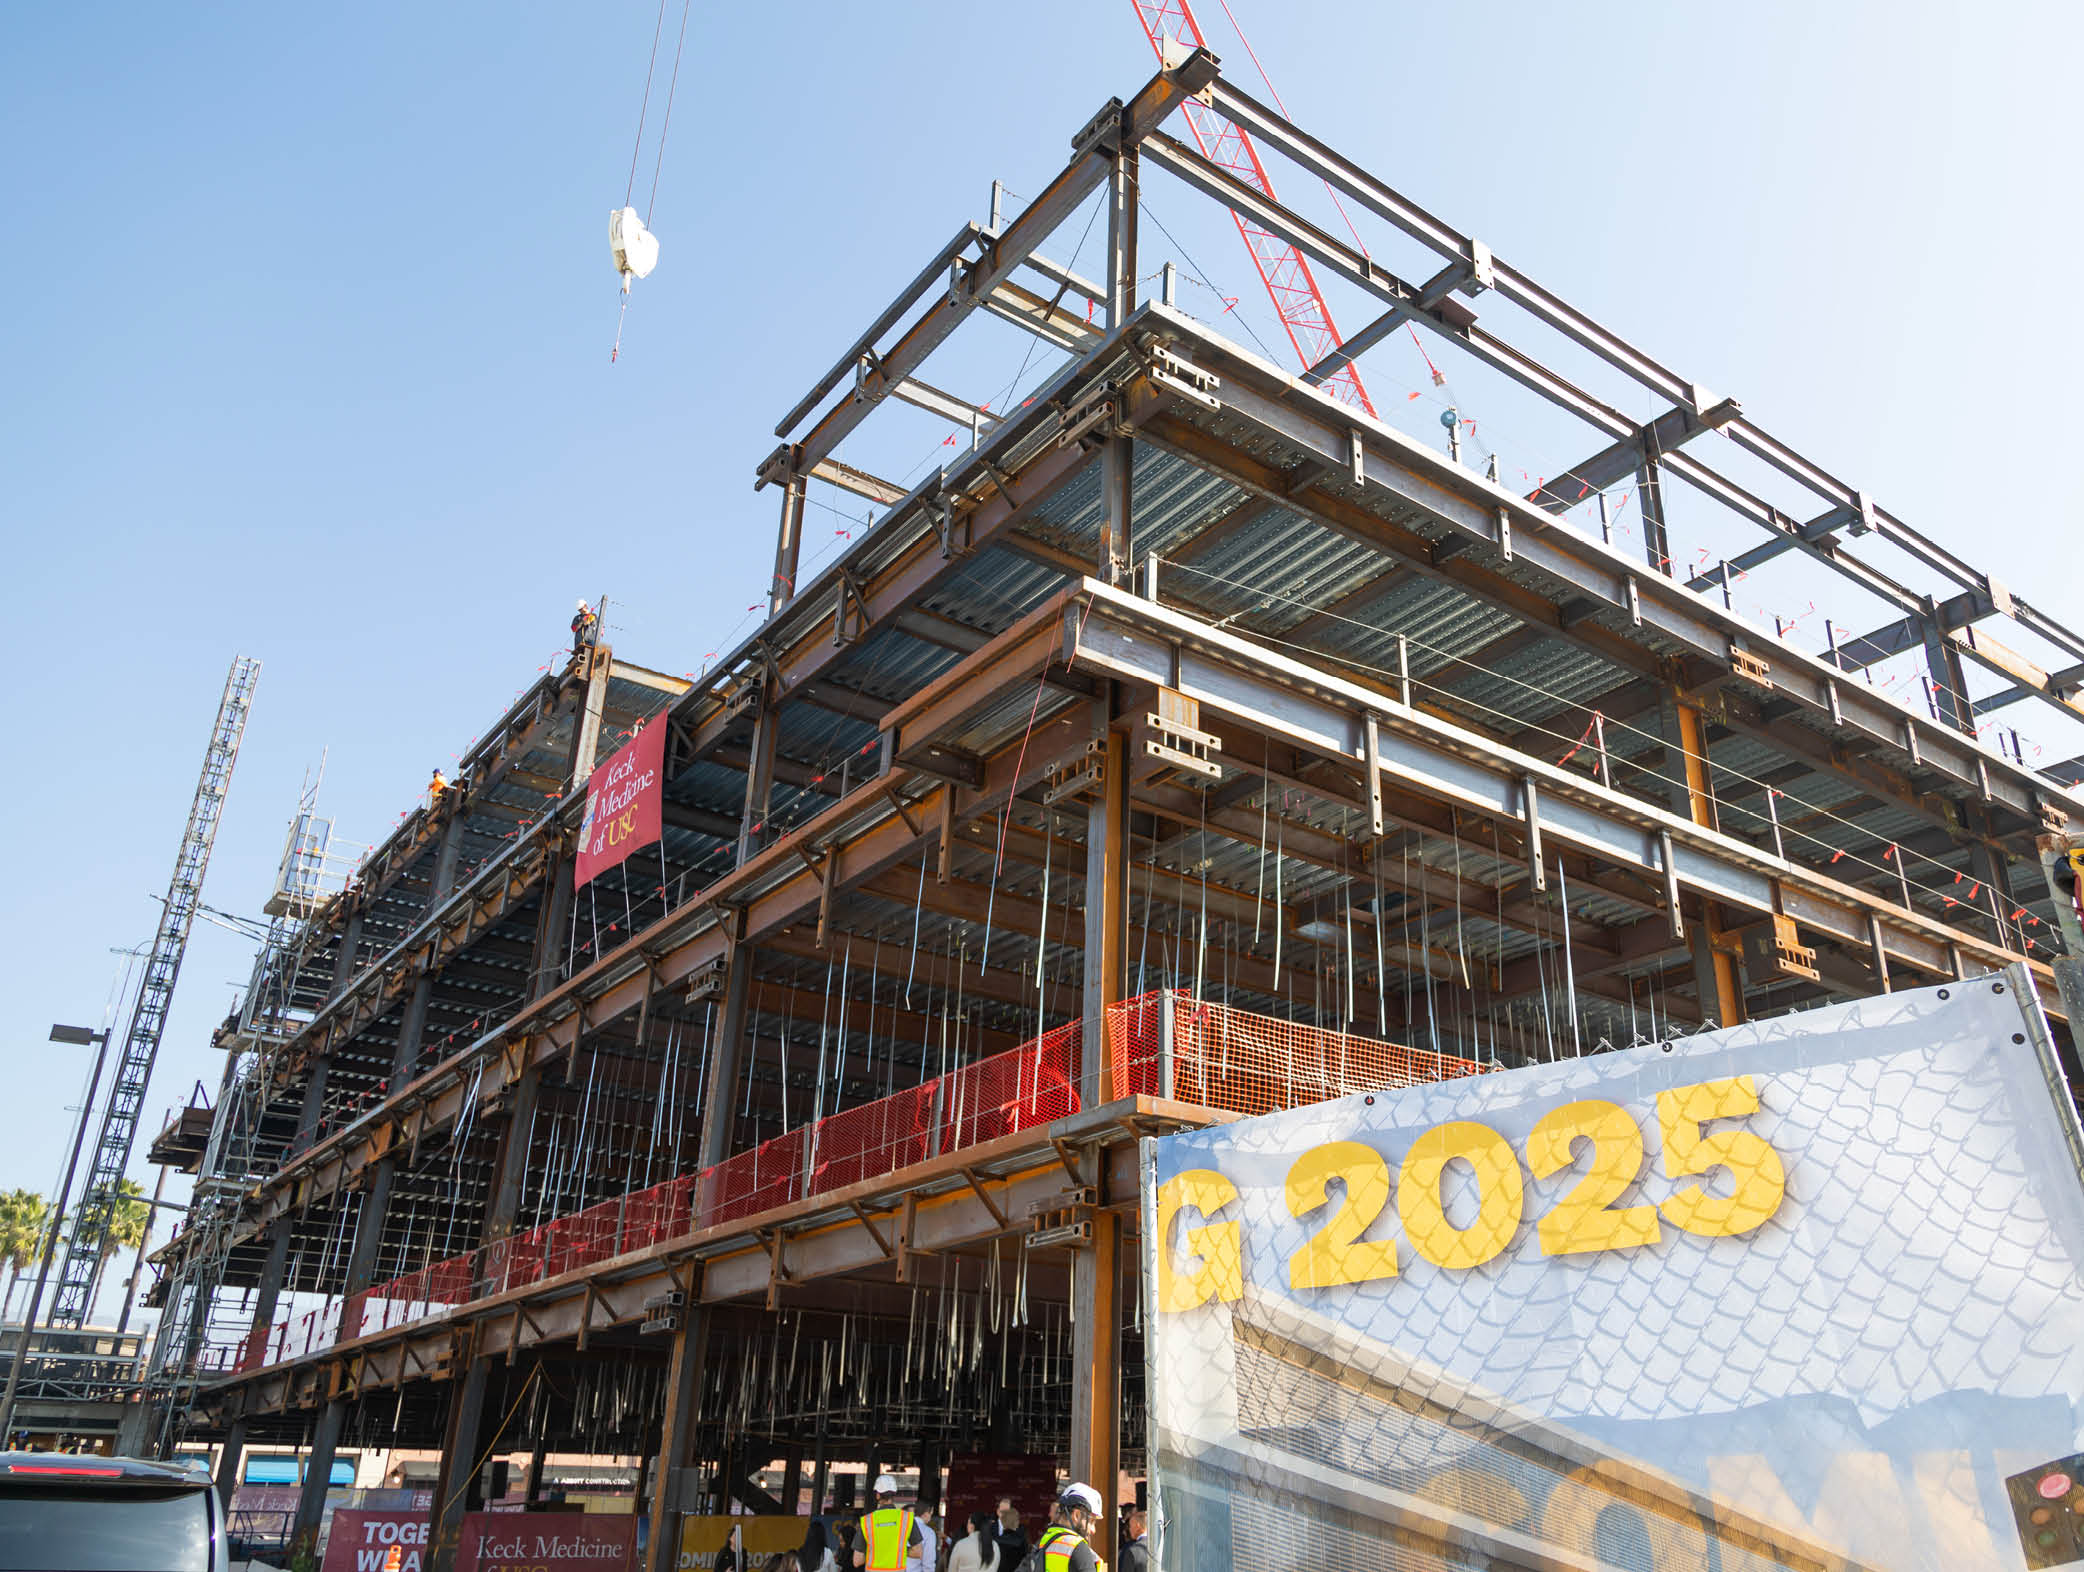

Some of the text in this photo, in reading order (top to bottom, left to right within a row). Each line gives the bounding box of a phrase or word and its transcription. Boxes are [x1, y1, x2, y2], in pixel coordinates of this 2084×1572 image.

[597, 769, 654, 823] Medicine
[604, 752, 635, 790] Keck
[593, 804, 638, 856] of USC
[1284, 1074, 1786, 1290] 2025
[476, 1535, 624, 1560] Keck Medicine
